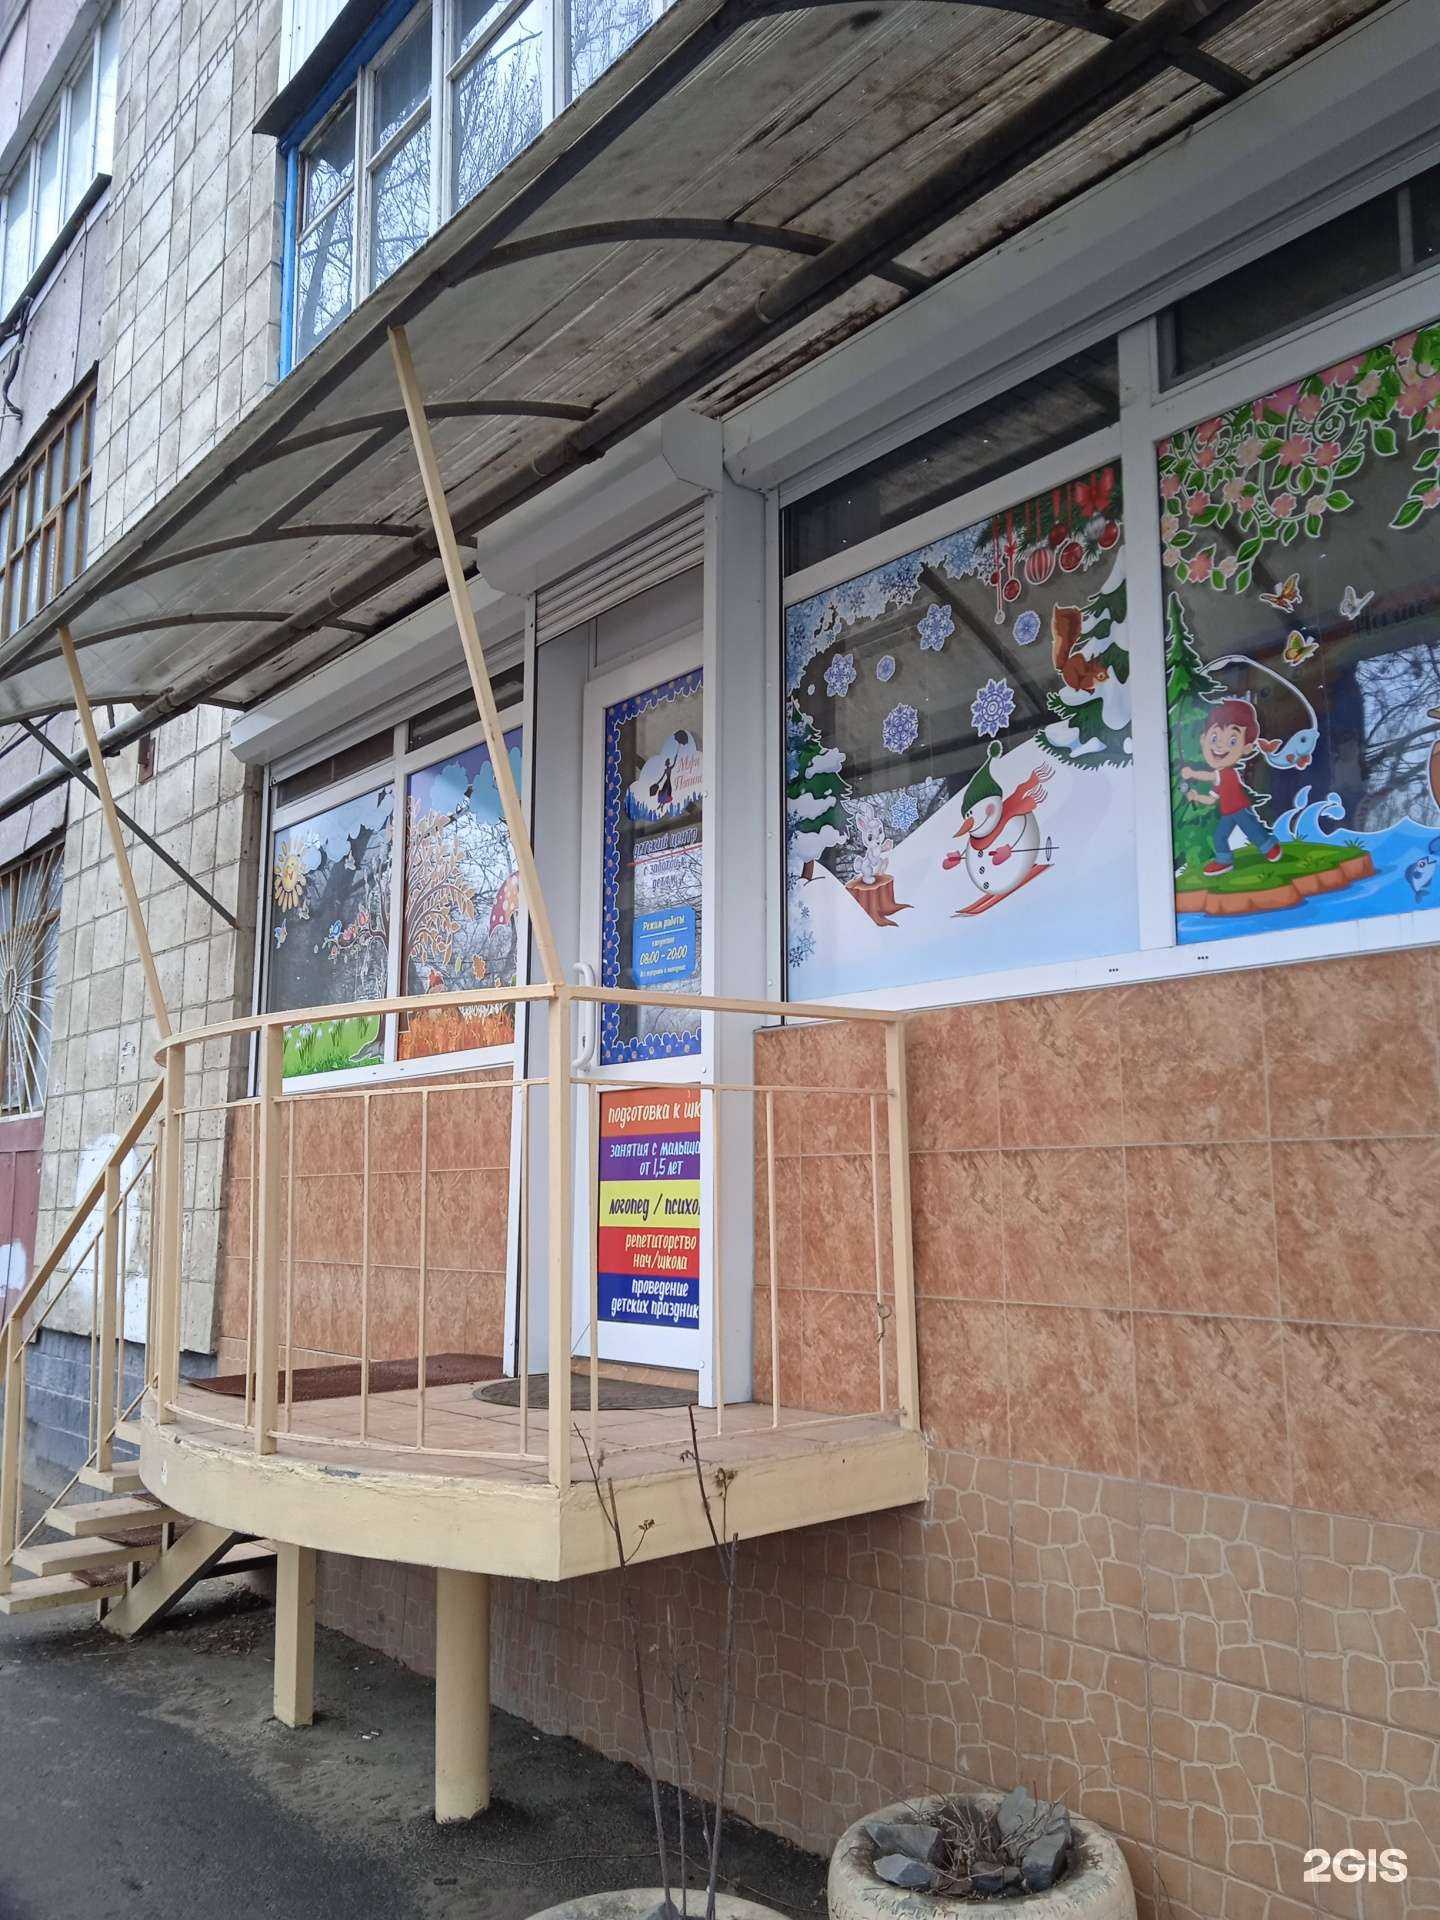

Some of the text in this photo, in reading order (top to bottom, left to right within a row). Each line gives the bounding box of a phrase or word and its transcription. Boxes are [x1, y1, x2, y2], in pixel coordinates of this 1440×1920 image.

[608, 1104, 670, 1129] подготовка
[673, 1102, 681, 1119] к
[610, 1142, 649, 1158] занятия
[652, 1142, 658, 1156] с
[640, 1157, 684, 1178] от 1,5 лет
[609, 1198, 650, 1222] логопед
[625, 1233, 697, 1254] репетиторство
[632, 1250, 688, 1270] нач/школа
[631, 1278, 689, 1300] проведение
[611, 1297, 699, 1323] детских праздник
